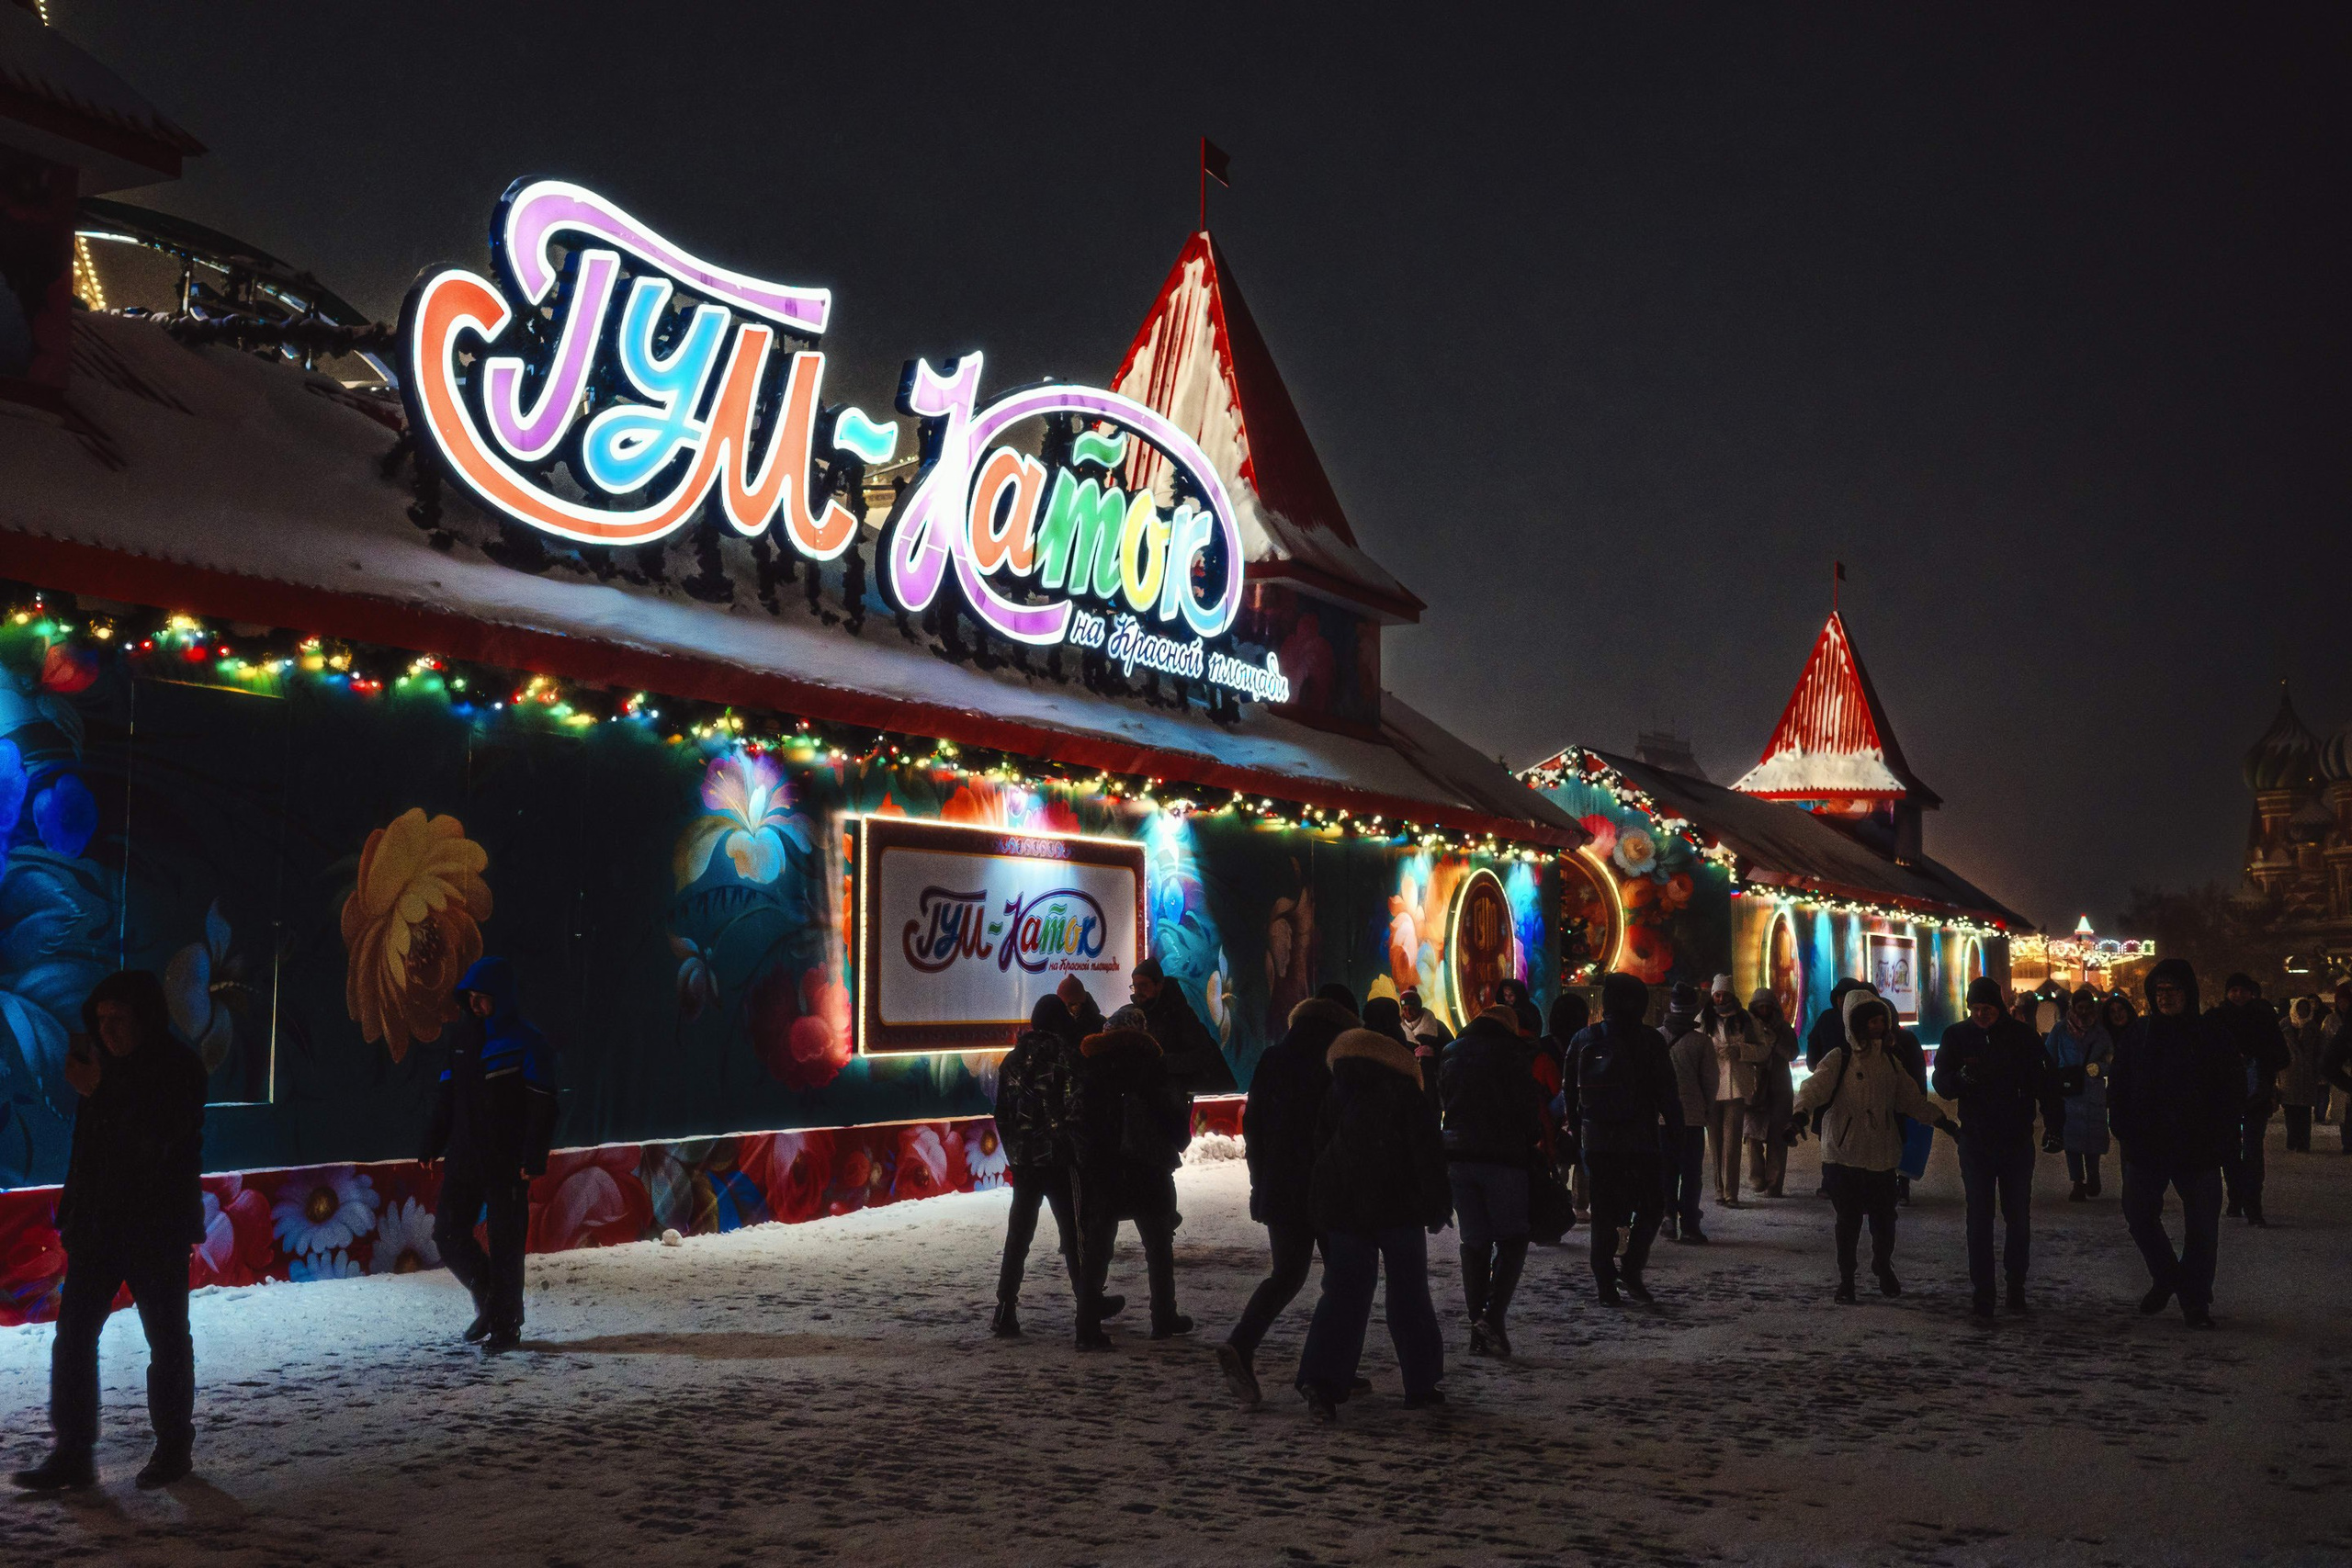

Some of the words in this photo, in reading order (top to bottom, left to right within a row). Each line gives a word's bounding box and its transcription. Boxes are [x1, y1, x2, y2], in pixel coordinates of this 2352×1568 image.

[1069, 610, 1105, 648] на
[1108, 613, 1204, 677] Красной
[1208, 652, 1290, 703] площади
